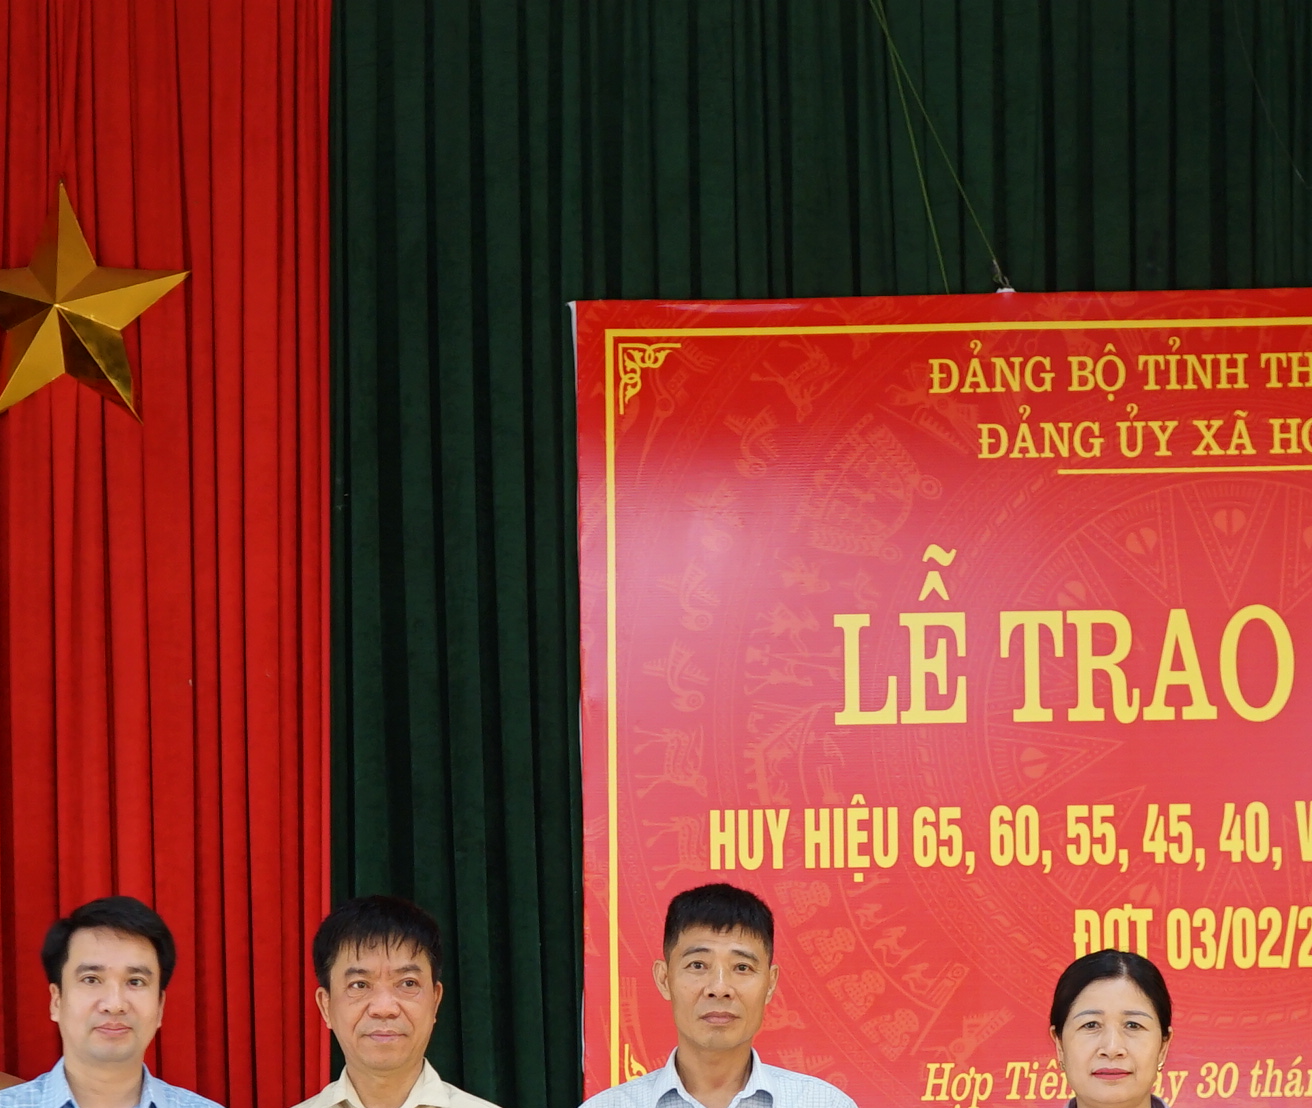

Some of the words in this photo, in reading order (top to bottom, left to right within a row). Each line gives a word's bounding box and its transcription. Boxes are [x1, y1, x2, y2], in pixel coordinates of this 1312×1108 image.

[930, 341, 1054, 393] ĐẢNG
[1069, 344, 1125, 400] BỘ
[1140, 338, 1247, 389] TỈNH
[979, 406, 1103, 458] ĐẢNG
[1117, 404, 1177, 457] ỦY
[1193, 411, 1255, 455] XÃ
[834, 545, 966, 725] LỄ
[1000, 605, 1294, 723] TRAO
[710, 809, 789, 870] HUY
[805, 794, 898, 882] HIỆU
[913, 807, 975, 874] 65,
[990, 805, 1051, 873] 60,
[1067, 805, 1128, 872] 55,
[1143, 804, 1205, 871] 45,
[1220, 802, 1281, 870] 40,
[1197, 1062, 1238, 1097] 30
